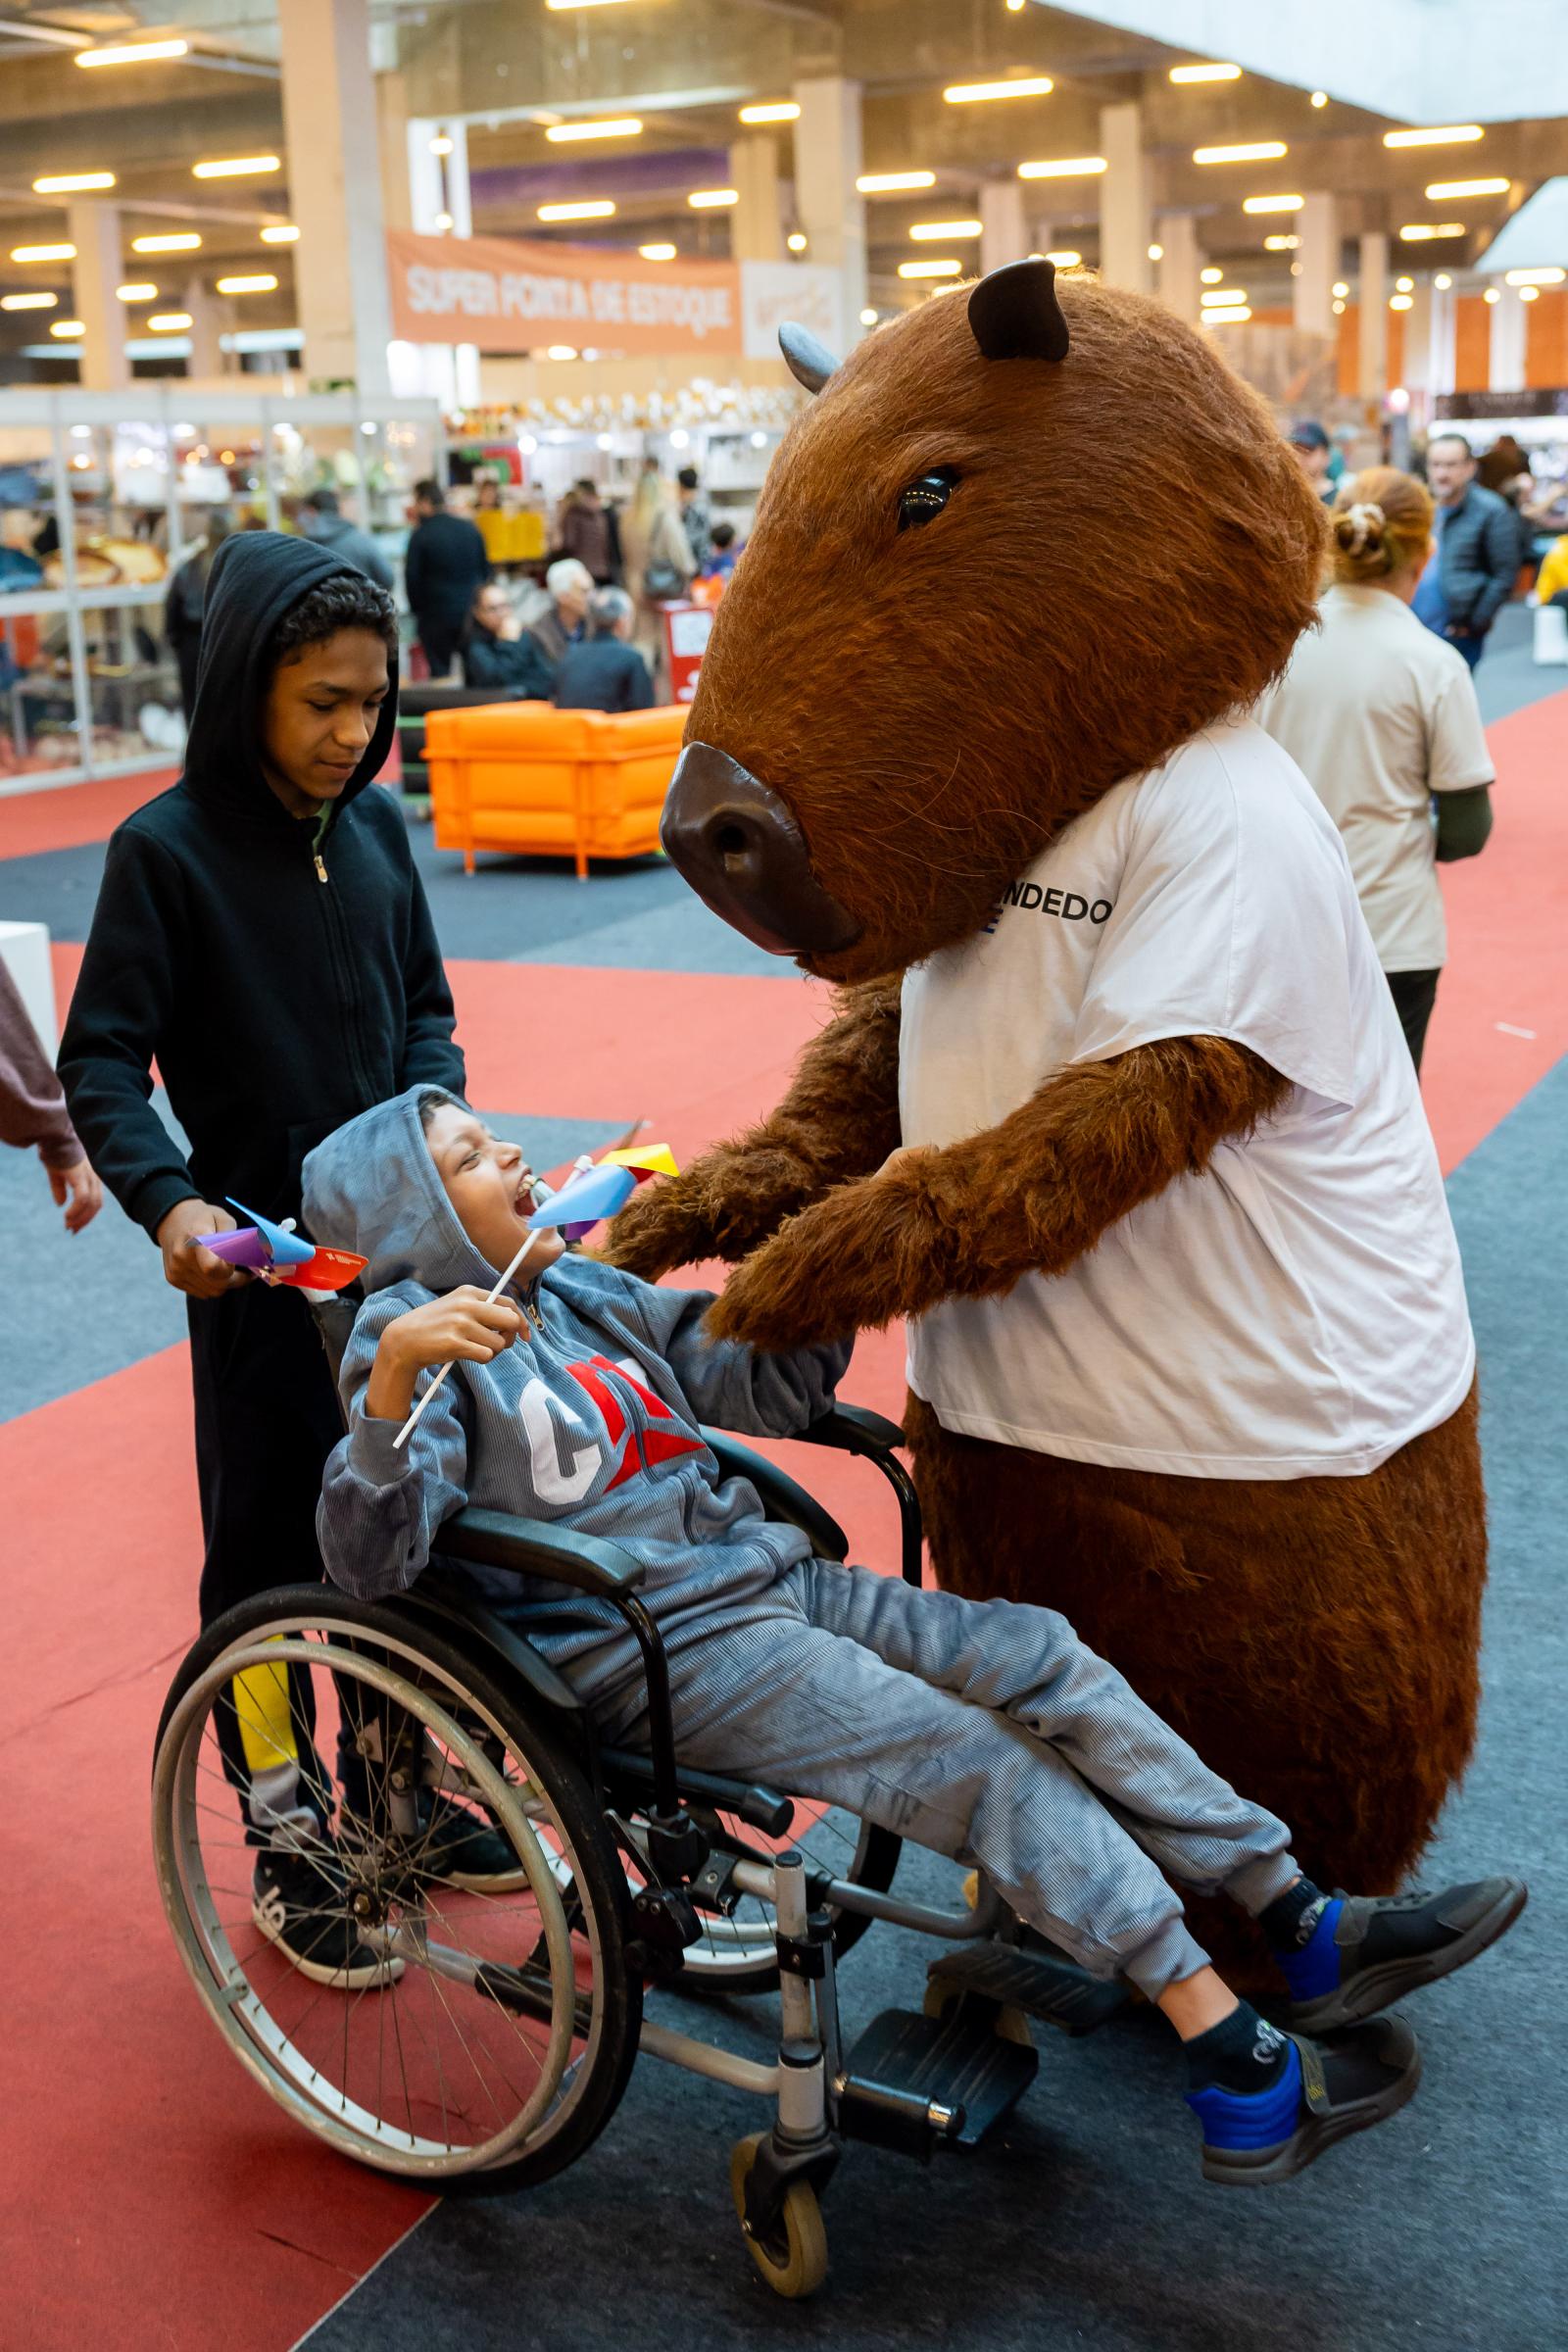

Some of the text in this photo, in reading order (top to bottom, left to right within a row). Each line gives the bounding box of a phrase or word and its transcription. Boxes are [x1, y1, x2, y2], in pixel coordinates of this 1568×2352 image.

[408, 266, 498, 315] SUPER
[591, 278, 624, 322] DE
[628, 282, 731, 337] ESTOQUE
[1001, 881, 1113, 924] NDEDO
